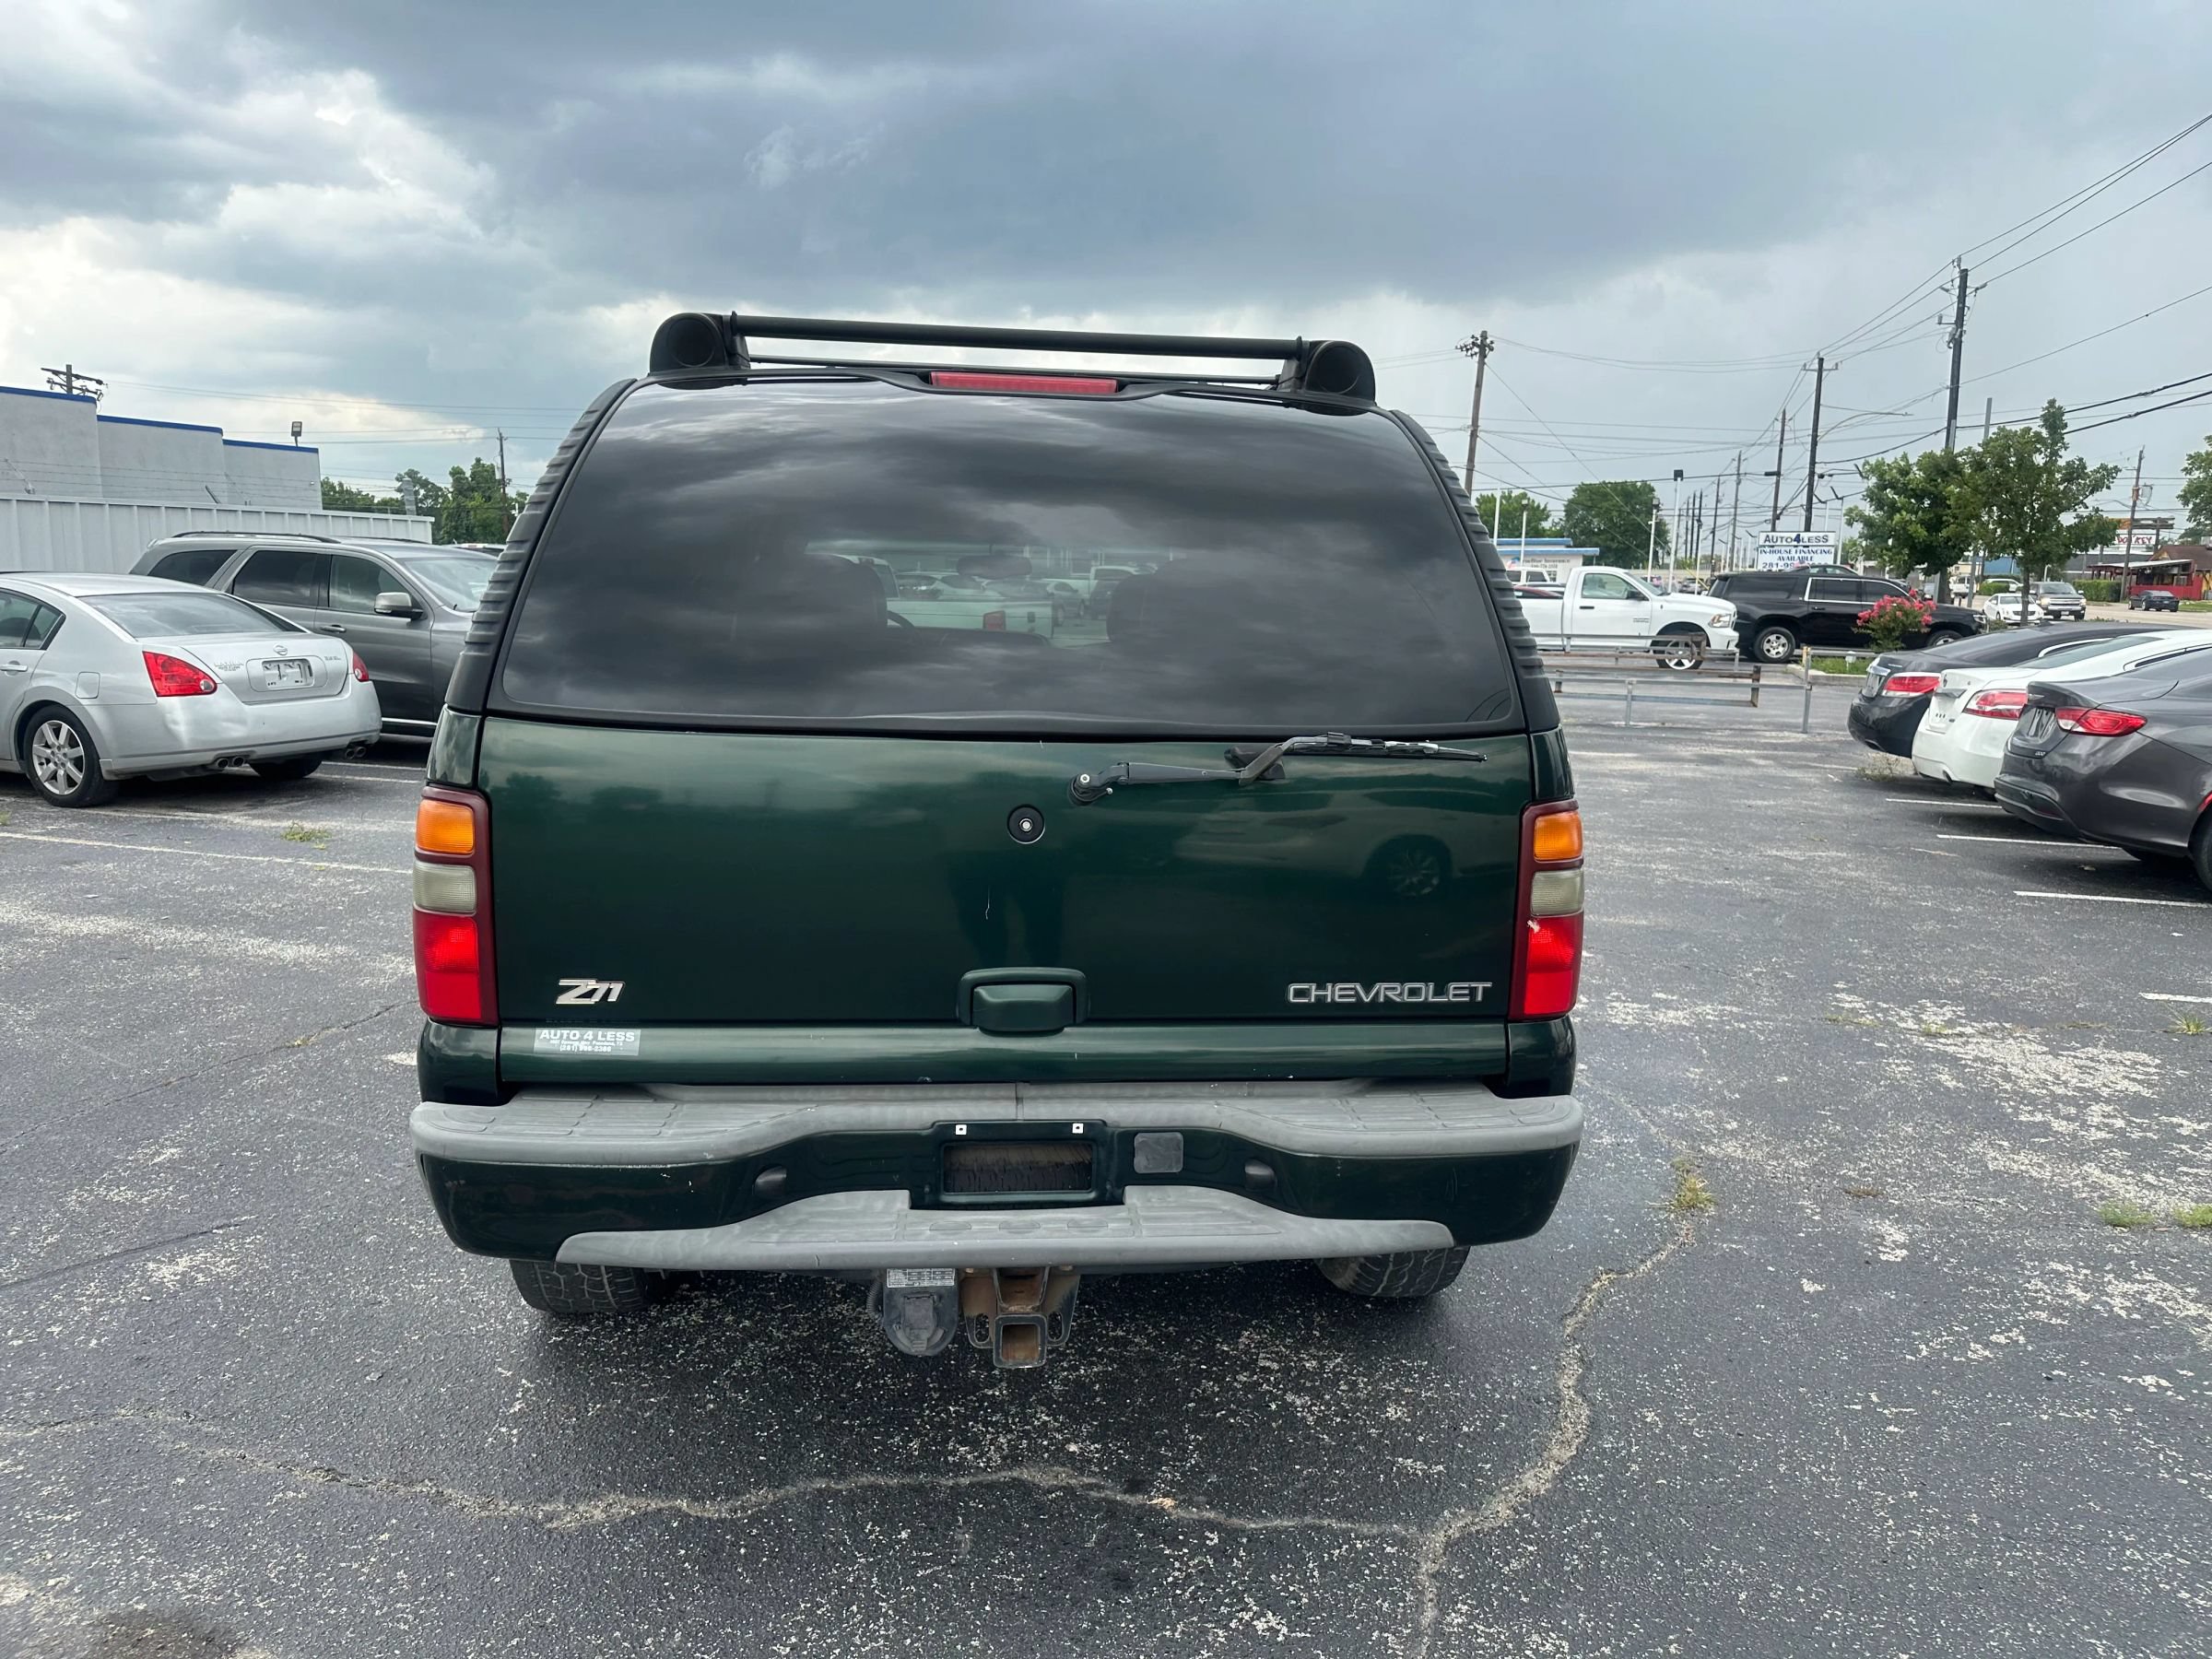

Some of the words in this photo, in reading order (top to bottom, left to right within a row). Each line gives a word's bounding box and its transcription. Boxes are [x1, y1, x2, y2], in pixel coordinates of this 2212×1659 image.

[556, 979, 625, 1005] Z71
[1288, 982, 1492, 1003] CHEVROLET
[539, 1030, 580, 1041] AUTO
[582, 1030, 594, 1041] 4
[597, 1031, 635, 1042] LESS
